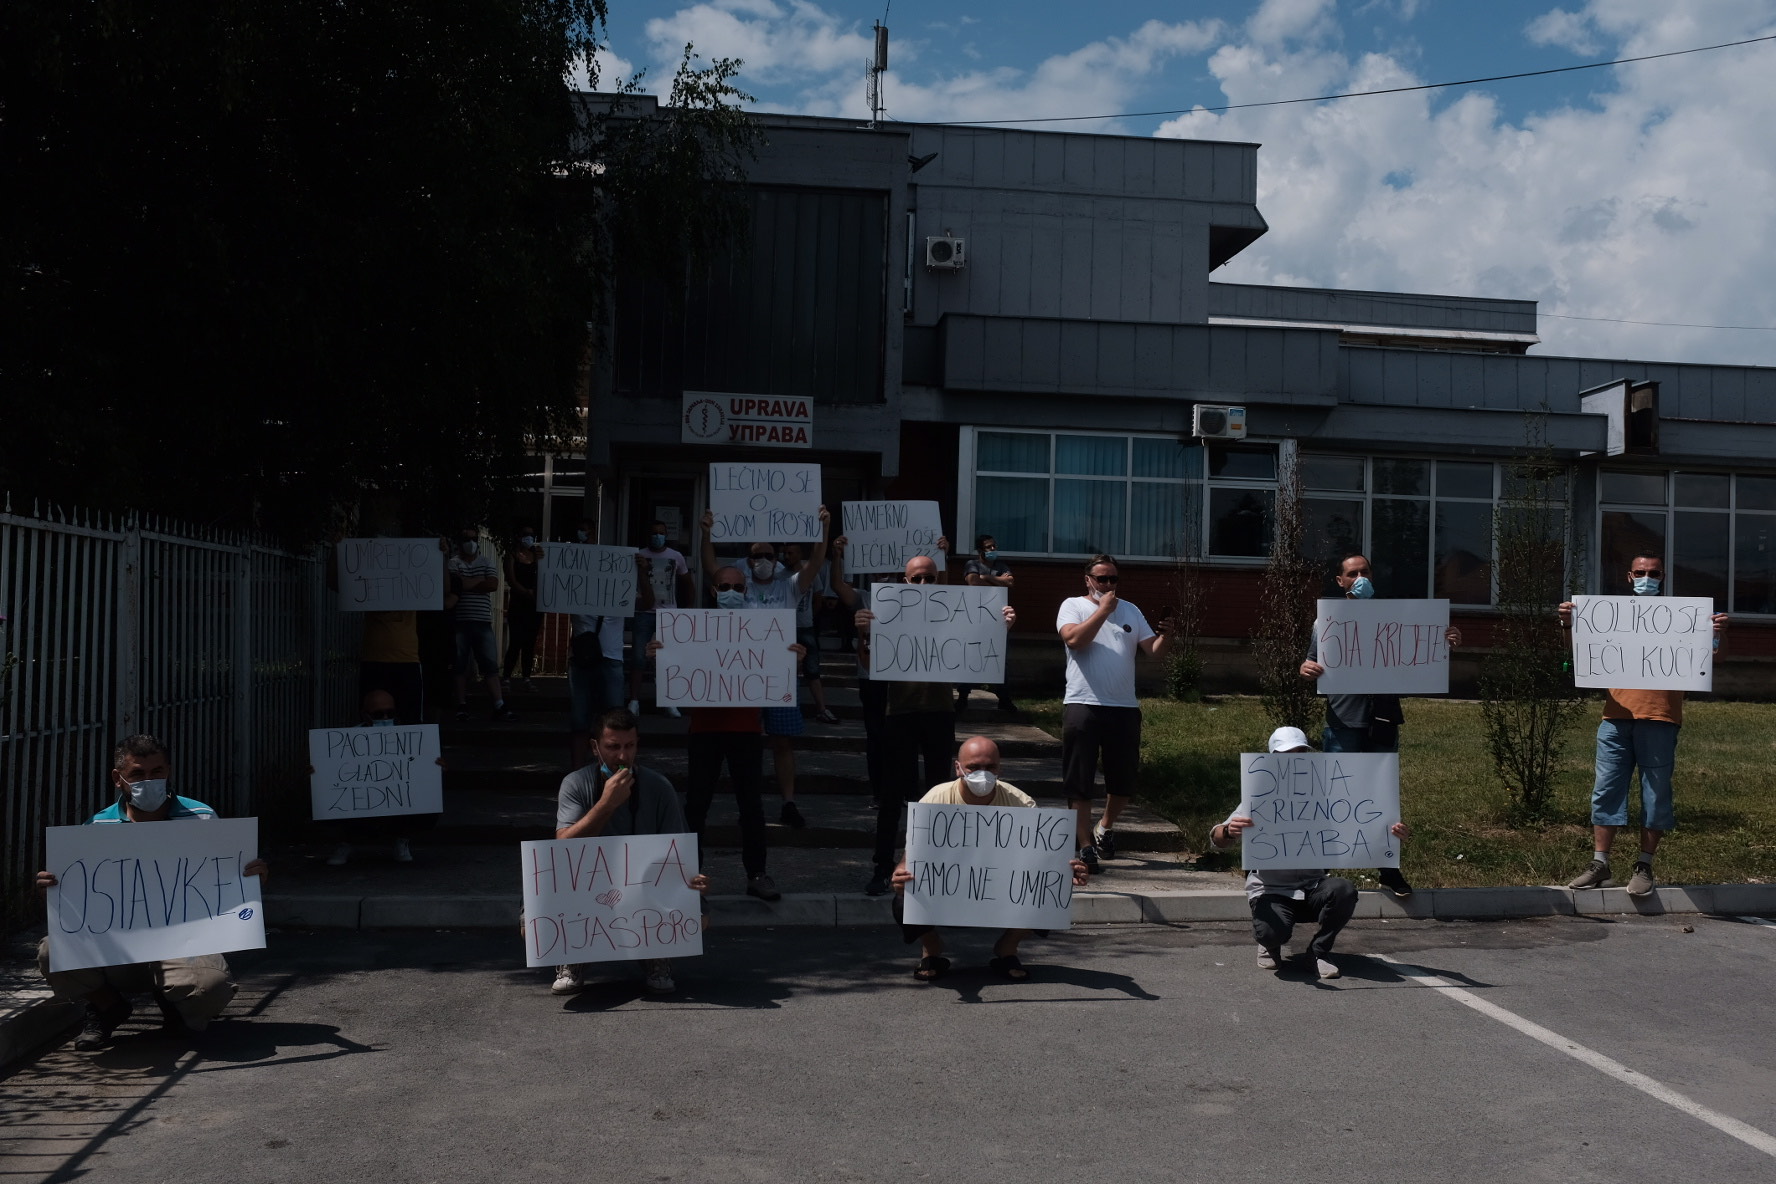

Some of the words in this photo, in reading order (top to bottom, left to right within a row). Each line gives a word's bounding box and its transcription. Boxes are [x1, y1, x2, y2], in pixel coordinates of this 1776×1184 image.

[730, 398, 809, 418] UPRAVA
[728, 424, 808, 444] УПРАВА
[713, 466, 786, 493] LEČIMO
[789, 470, 814, 494] SE
[711, 512, 756, 538] SVOM
[843, 503, 908, 531] NAMERNO
[598, 550, 633, 573] BROJ
[542, 572, 632, 608] UMRLIH?
[875, 585, 998, 625] SPISAK
[660, 611, 785, 643] POLITIKA
[1575, 598, 1672, 635] KOLIKO
[1673, 605, 1707, 634] SE
[715, 648, 765, 670] VAN
[874, 632, 1000, 673] DONACIJA
[1320, 616, 1362, 669] ŠTA
[1576, 639, 1625, 677] LEČI
[665, 664, 793, 703] BOLNICE!
[327, 730, 423, 759] PACIJENTI
[338, 756, 415, 782] GLADNI
[1248, 756, 1354, 798] SMENA
[328, 781, 412, 811] ŽEDNI
[1250, 798, 1383, 824] KRIZNOG
[1034, 812, 1069, 851] KG
[532, 838, 692, 896] HVALA
[58, 850, 254, 935] OSTAVKE!
[910, 860, 961, 897] TAMO
[968, 866, 999, 901] NE
[1009, 869, 1073, 909] UMIRU
